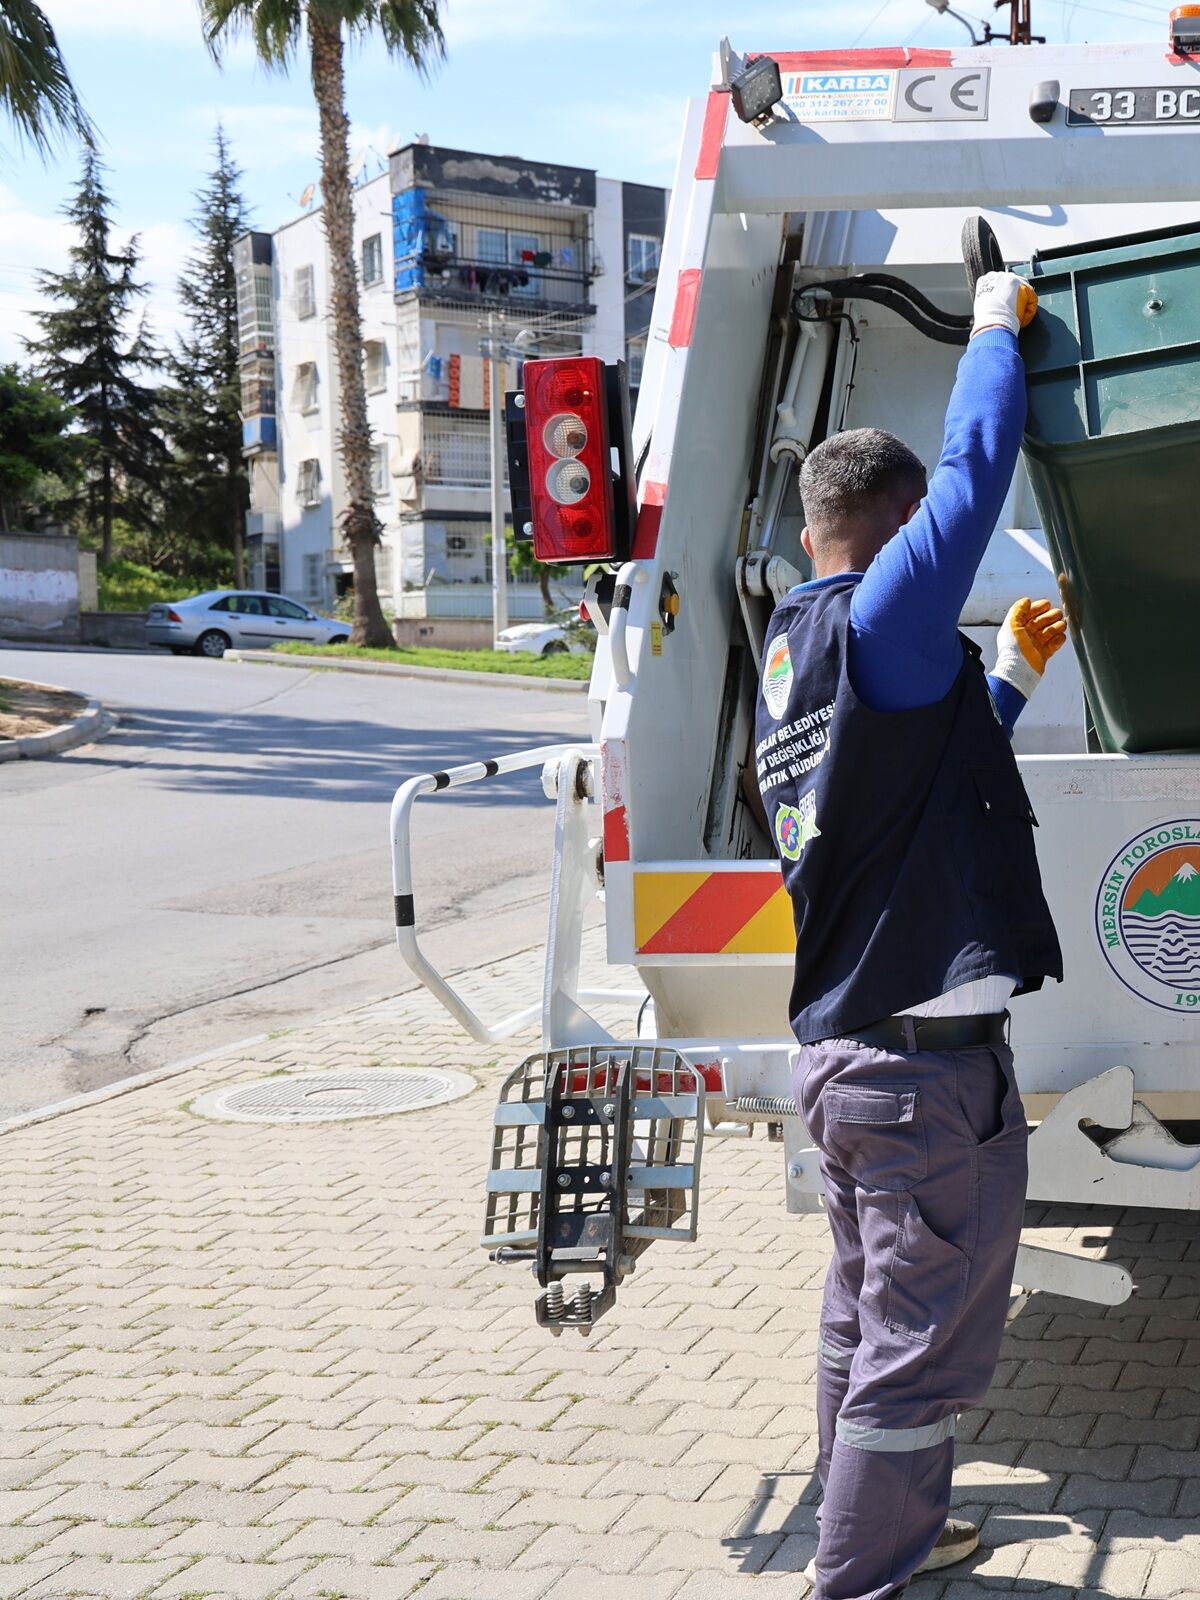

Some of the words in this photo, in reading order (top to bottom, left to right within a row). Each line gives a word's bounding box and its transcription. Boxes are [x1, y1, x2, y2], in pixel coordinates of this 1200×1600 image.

[807, 76, 887, 92] KARBA
[809, 100, 829, 108] 312
[832, 99, 853, 107] 267
[1091, 91, 1135, 120] 33
[777, 699, 836, 743] BELEDİYESİ
[766, 727, 825, 769] DEĞİŞİKLİĞİ
[1102, 870, 1125, 949] MERSİN
